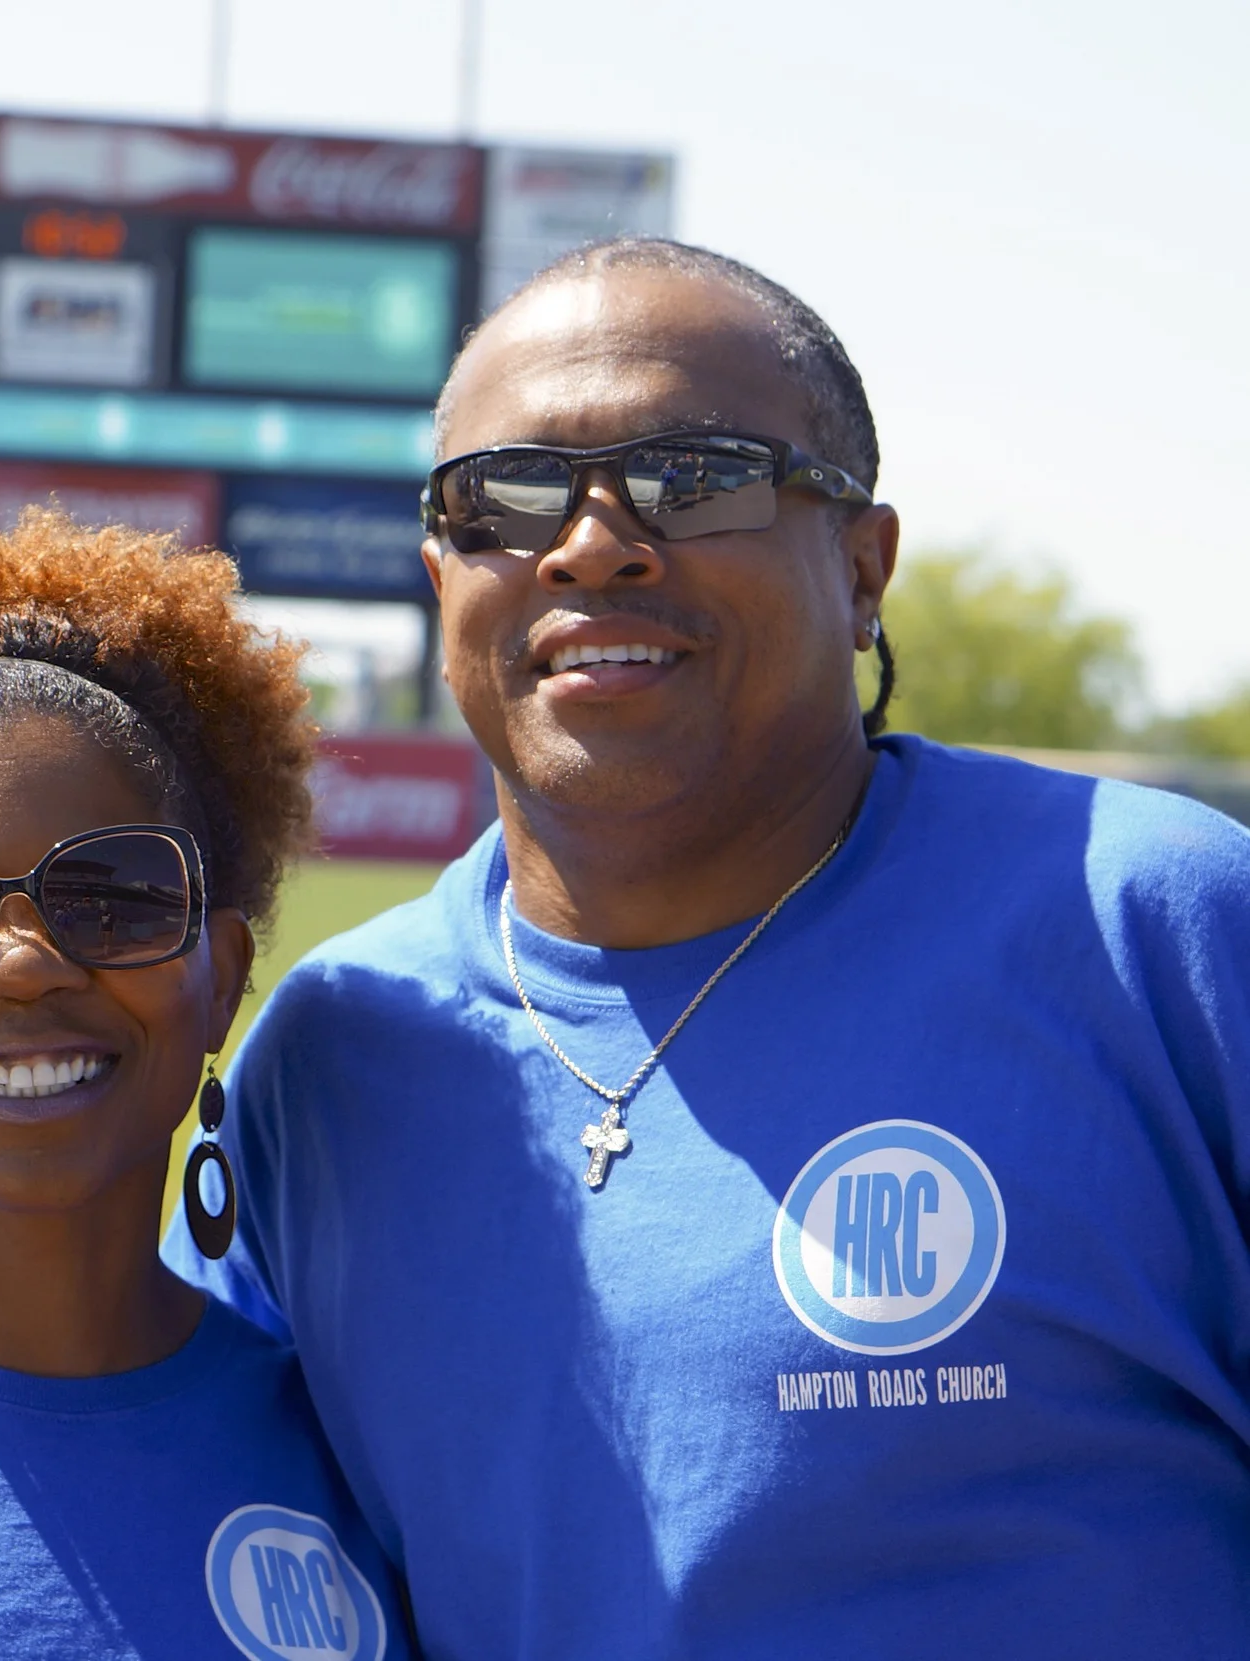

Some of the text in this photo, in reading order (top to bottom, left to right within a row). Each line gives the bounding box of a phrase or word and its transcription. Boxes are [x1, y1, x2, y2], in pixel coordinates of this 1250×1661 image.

[832, 1170, 939, 1298] HRC
[777, 1363, 1007, 1411] HAMPTON ROADS CHURCH
[249, 1544, 347, 1652] HRC
